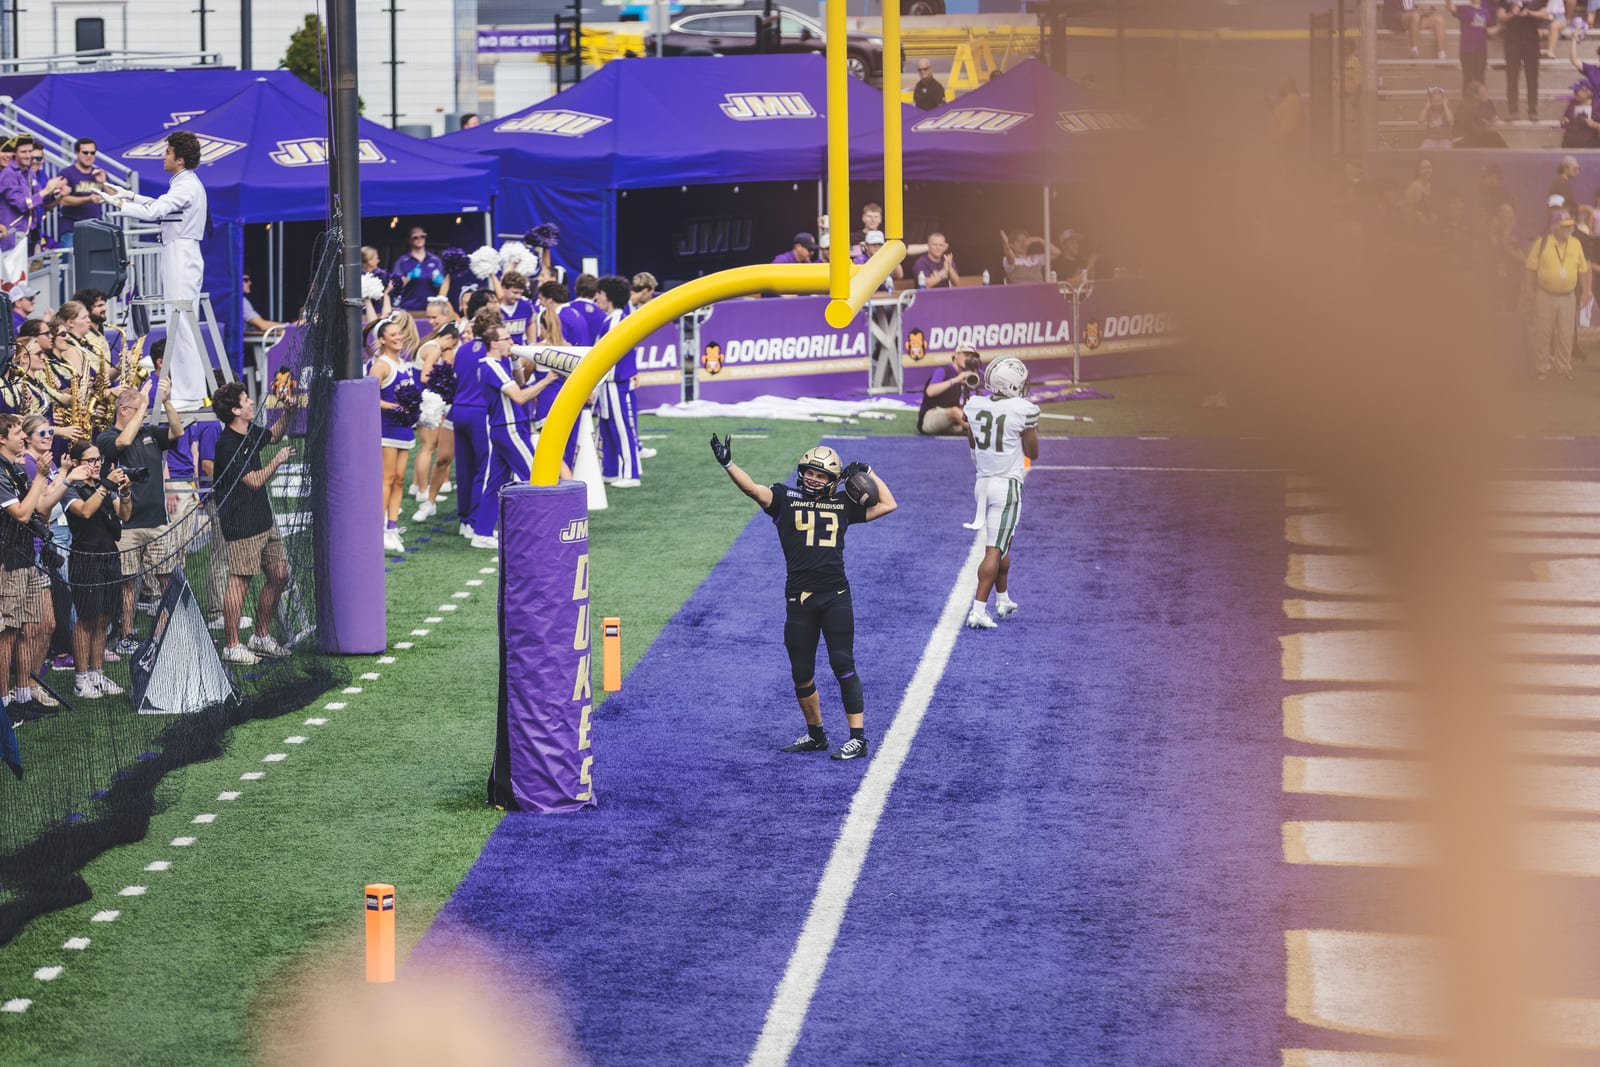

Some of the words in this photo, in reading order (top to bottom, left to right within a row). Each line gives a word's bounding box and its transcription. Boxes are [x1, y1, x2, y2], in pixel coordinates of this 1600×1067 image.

[722, 94, 814, 119] JMU
[914, 109, 1030, 131] JMU
[497, 111, 608, 134] JMU
[678, 219, 752, 257] JMU
[724, 332, 867, 364] DOORGORILLA
[928, 320, 1070, 350] DOORGORILLA
[535, 350, 580, 372] JMU
[975, 410, 1006, 452] 31
[790, 500, 815, 508] JAMES
[815, 502, 845, 510] MADISON
[794, 510, 839, 547] 43
